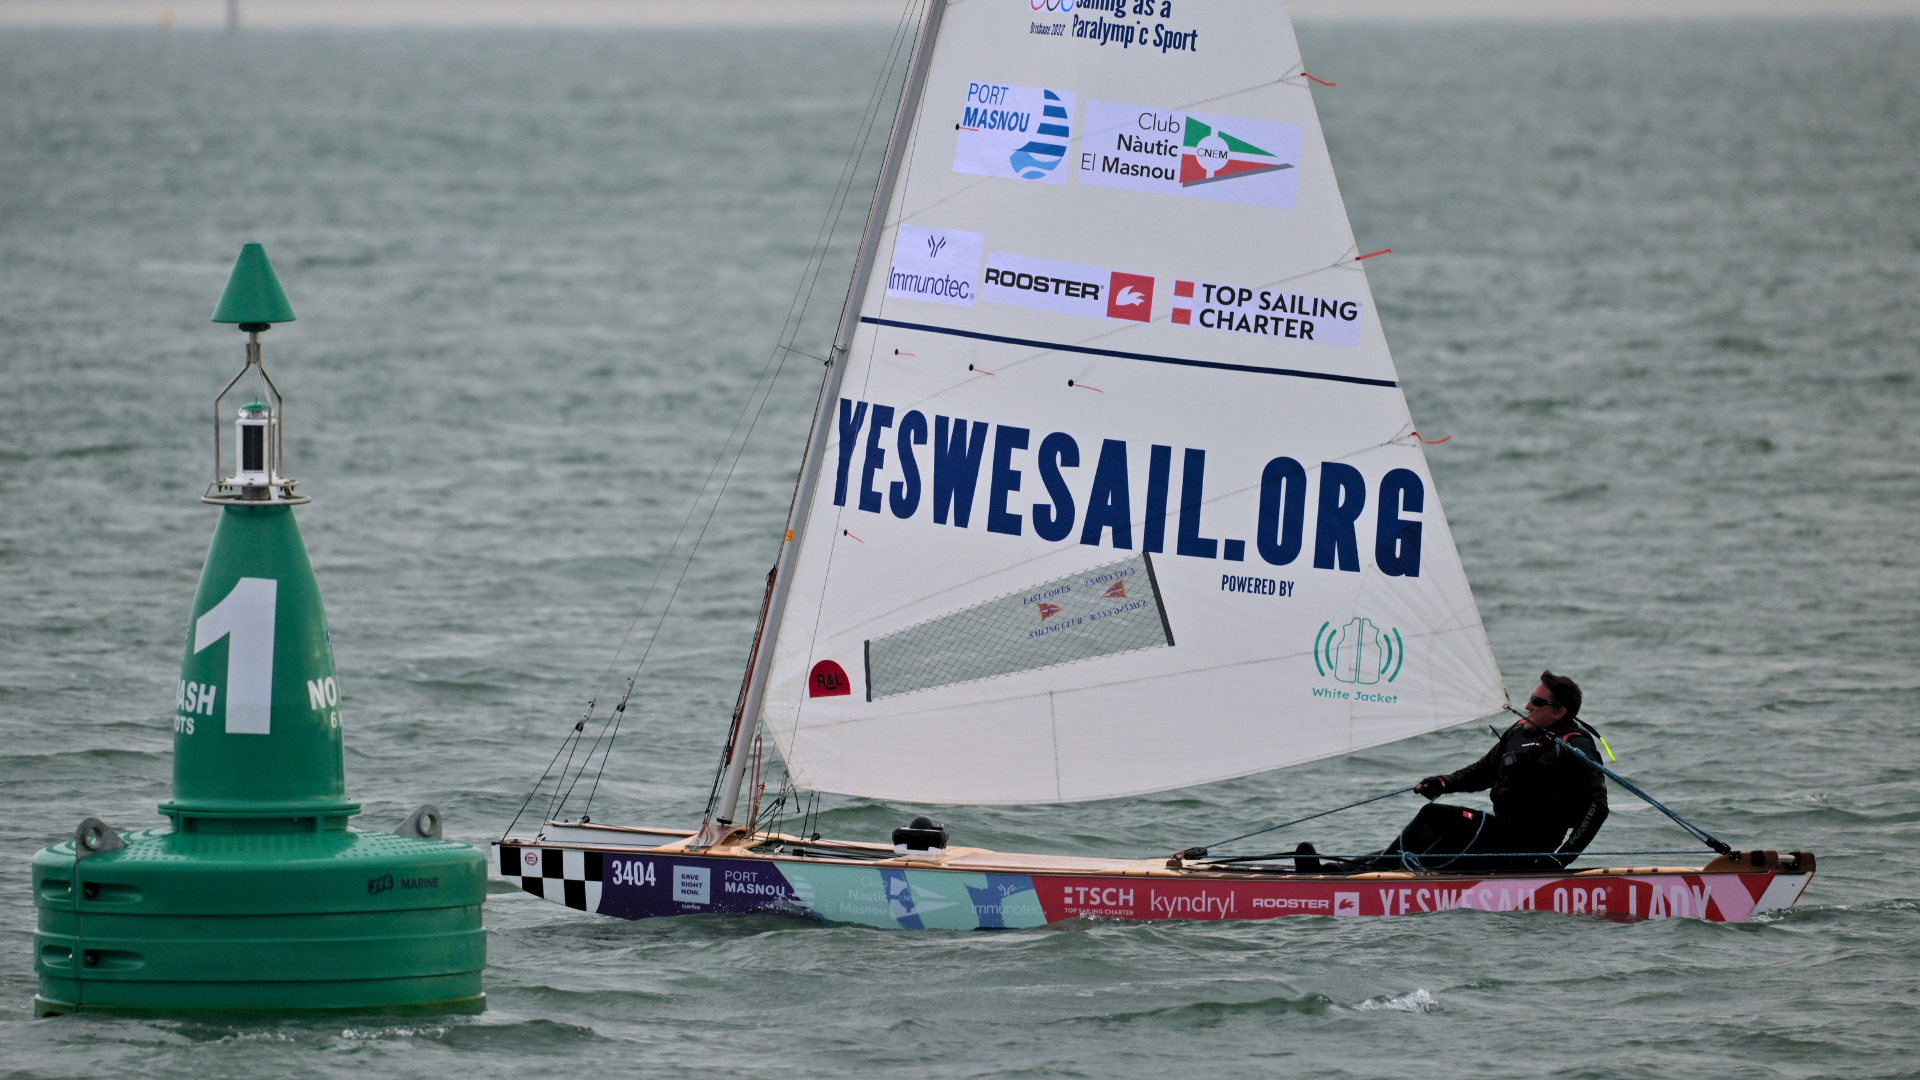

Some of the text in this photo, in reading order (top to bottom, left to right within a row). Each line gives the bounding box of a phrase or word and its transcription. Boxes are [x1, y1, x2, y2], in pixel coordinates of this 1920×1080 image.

[1132, 0, 1156, 17] as
[1160, 0, 1172, 19] a
[1051, 23, 1066, 36] 2032
[1072, 14, 1198, 54] Paralympc Sport
[967, 82, 1009, 107] PORT
[962, 108, 1030, 134] MASNOU
[1138, 112, 1181, 134] Club
[1116, 133, 1179, 158] Nàutic
[1196, 147, 1228, 160] CNEM
[1081, 152, 1176, 182] El Masnou
[984, 267, 1100, 301] ROOSTER
[1202, 282, 1358, 322] TOP SAILING
[1199, 308, 1315, 341] CHARTER
[833, 397, 1425, 578] YESWESAIL.ORG
[1044, 585, 1071, 599] COWES
[1221, 574, 1294, 597] POWERED BY
[194, 577, 277, 734] 1
[816, 673, 843, 690] R&L
[175, 678, 217, 717] ASH
[307, 676, 337, 711] NO
[1312, 687, 1398, 704] White Jacket
[174, 714, 195, 736] OTS
[330, 711, 338, 729] 6
[400, 877, 439, 890] MARINE
[612, 860, 657, 887] 3404
[681, 873, 700, 881] SAVE
[725, 870, 758, 883] PORT
[861, 875, 888, 888] Club
[681, 881, 703, 889] SIGHT
[725, 881, 786, 896] MASNOU
[1075, 886, 1134, 907] TSCH
[1150, 889, 1236, 919] kyndryl
[1252, 898, 1330, 909] ROOSTER
[839, 902, 887, 915] Masnou
